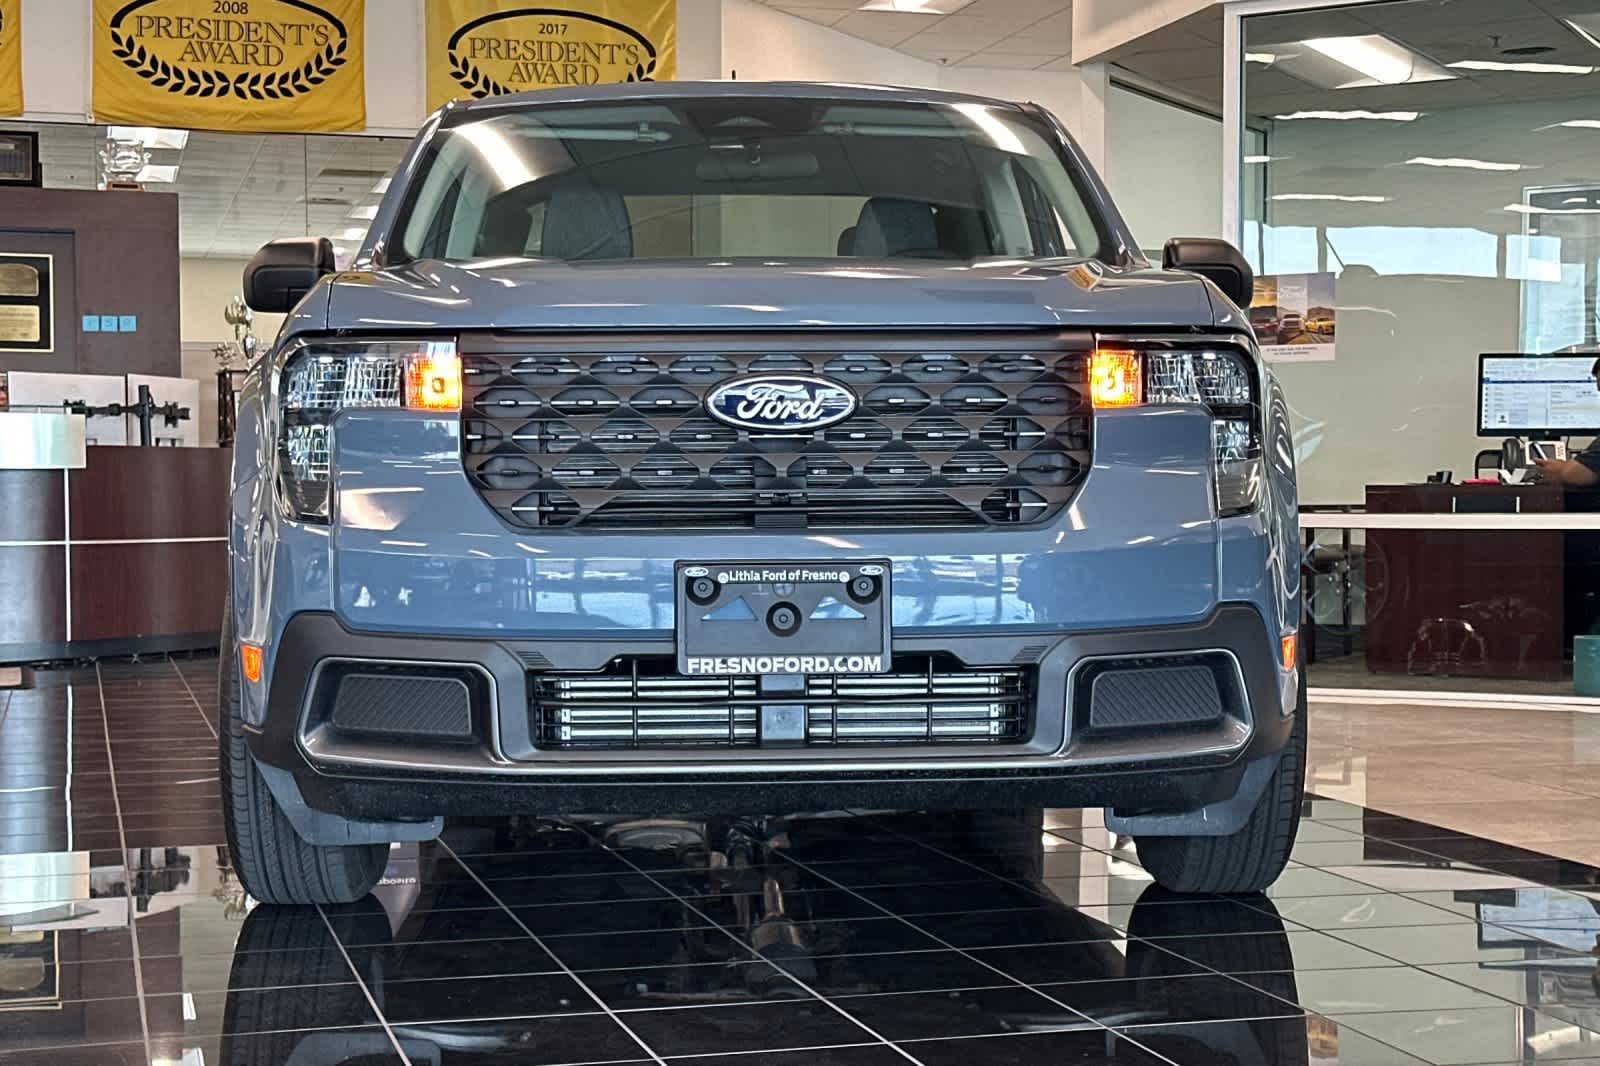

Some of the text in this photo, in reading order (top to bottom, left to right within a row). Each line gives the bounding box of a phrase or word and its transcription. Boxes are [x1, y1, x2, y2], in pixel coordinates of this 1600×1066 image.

[213, 0, 249, 15] 2008
[135, 15, 330, 47] PRESIDENT'S
[538, 23, 569, 35] 2017
[177, 40, 284, 67] AWARD
[468, 37, 640, 66] PRESIDENT'S
[507, 62, 600, 86] AWARD
[736, 382, 825, 421] Ford
[729, 569, 838, 581] Lithia Ford of Fresno
[687, 656, 882, 673] FRESNOFORD.COM
